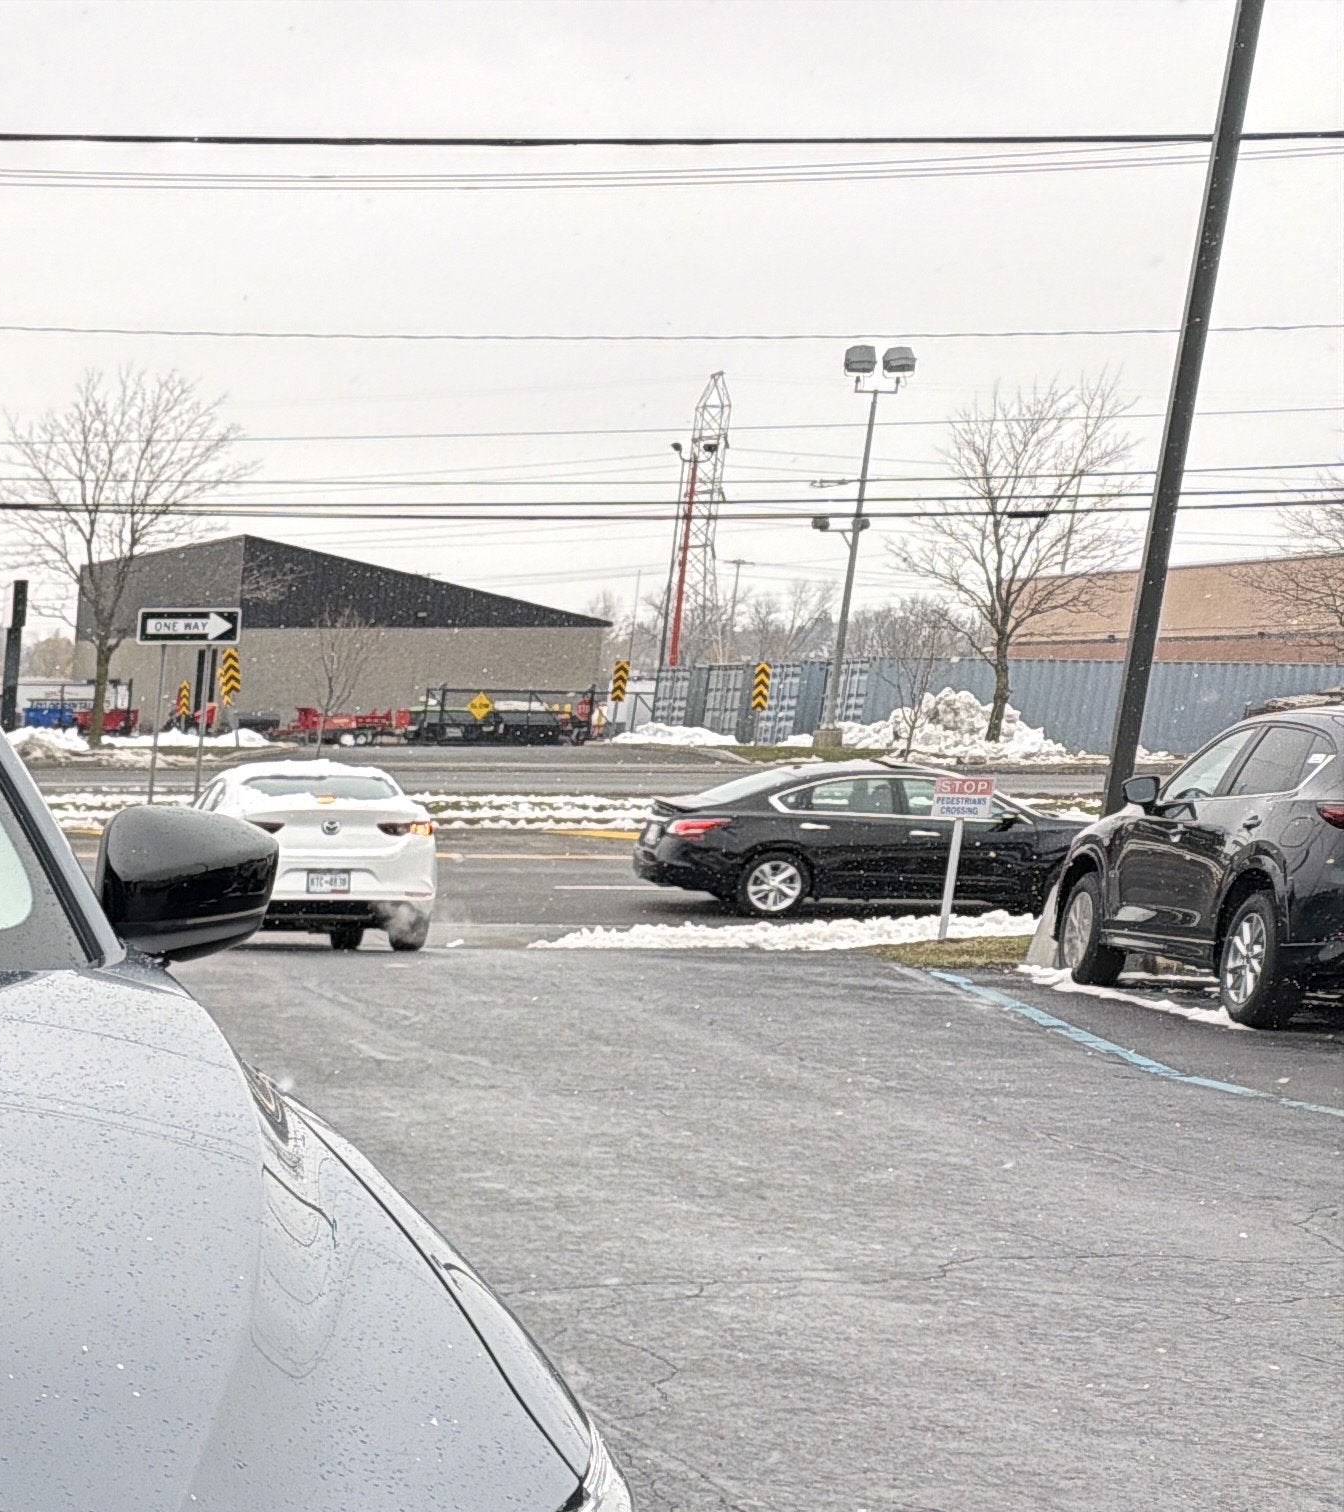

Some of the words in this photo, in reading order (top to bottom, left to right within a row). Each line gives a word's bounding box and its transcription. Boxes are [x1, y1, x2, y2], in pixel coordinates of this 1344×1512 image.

[154, 621, 179, 632] ONE
[184, 621, 209, 631] WAY
[941, 780, 988, 793] STOP
[936, 796, 987, 805] PEDESTRIANS
[940, 806, 978, 815] CROSSING
